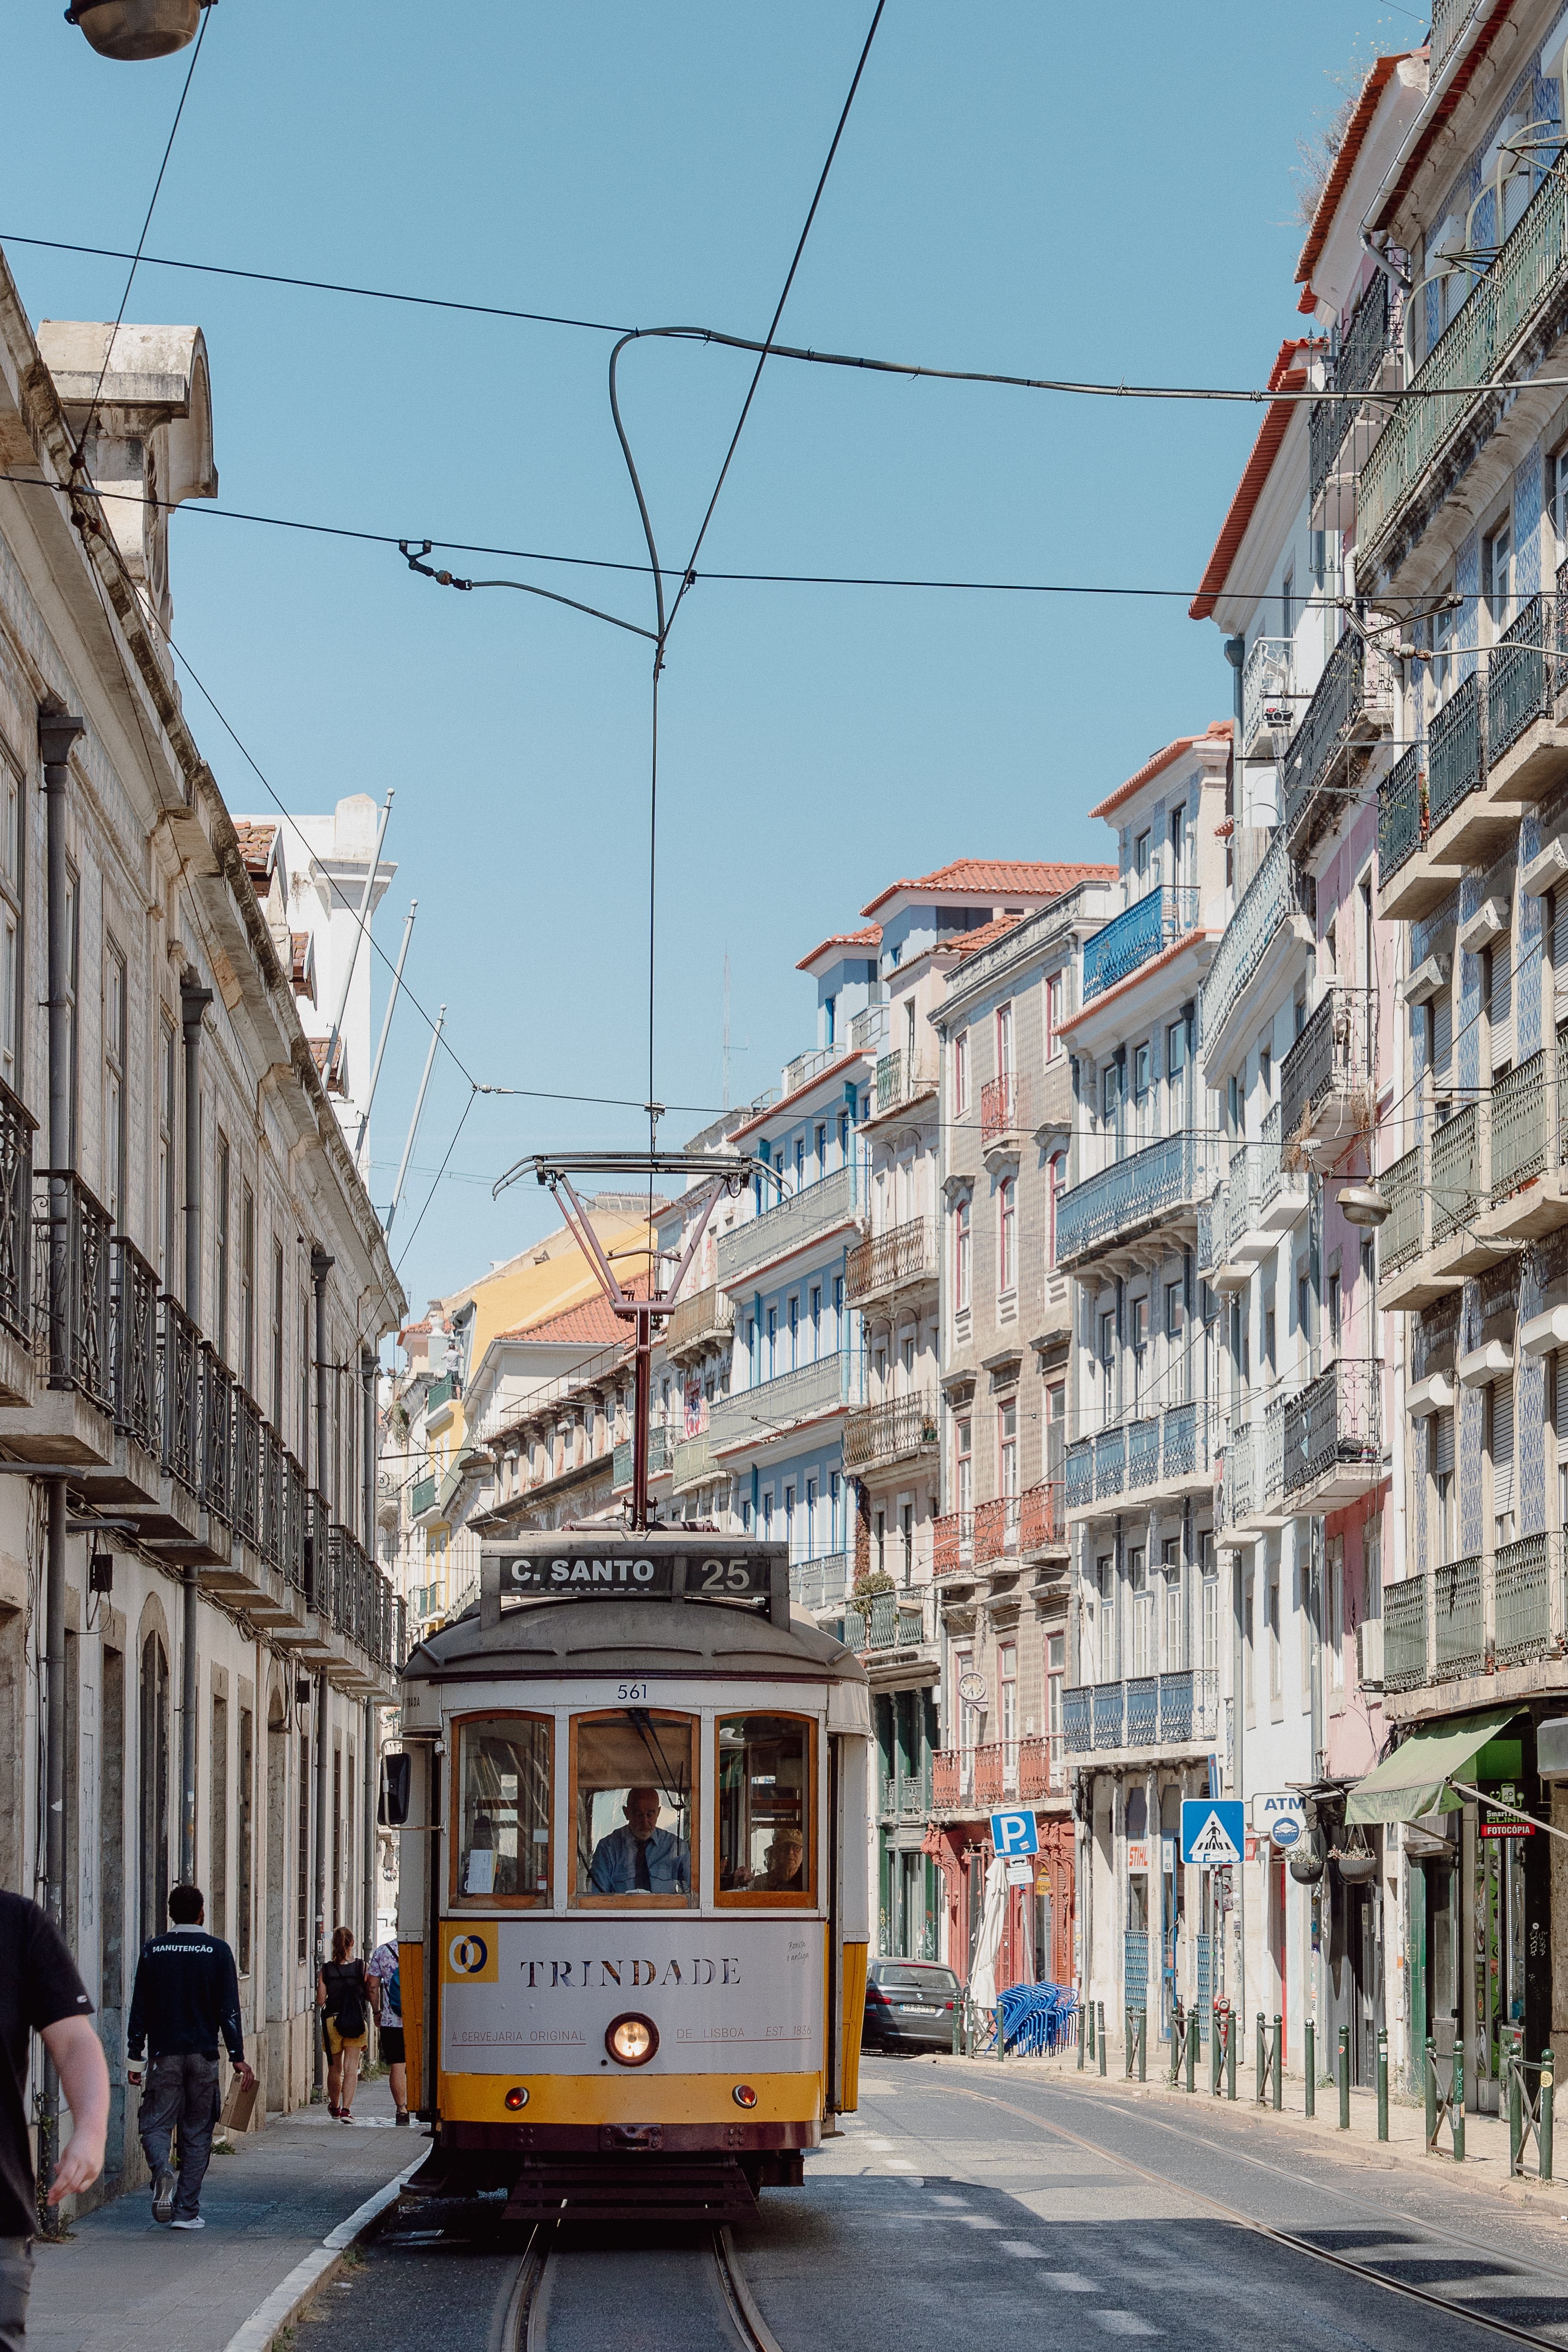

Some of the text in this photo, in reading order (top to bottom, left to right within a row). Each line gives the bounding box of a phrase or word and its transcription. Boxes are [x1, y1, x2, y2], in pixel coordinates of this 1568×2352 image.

[511, 1559, 654, 1581] C. SANTO
[701, 1559, 750, 1590] 25
[617, 1684, 647, 1700] 561
[1264, 1797, 1307, 1810] ATM
[1000, 1816, 1026, 1852] P
[1487, 1825, 1530, 1835] FOTOCÓPIA
[1129, 1846, 1148, 1866] STIHL
[153, 1945, 213, 1953] MANUTENÇÃO
[520, 1958, 742, 1988] TRINDADE
[452, 2030, 586, 2042] A CERVEJARIA ORIGINAL
[677, 2025, 812, 2039] DE LISBOA EST. 1836
